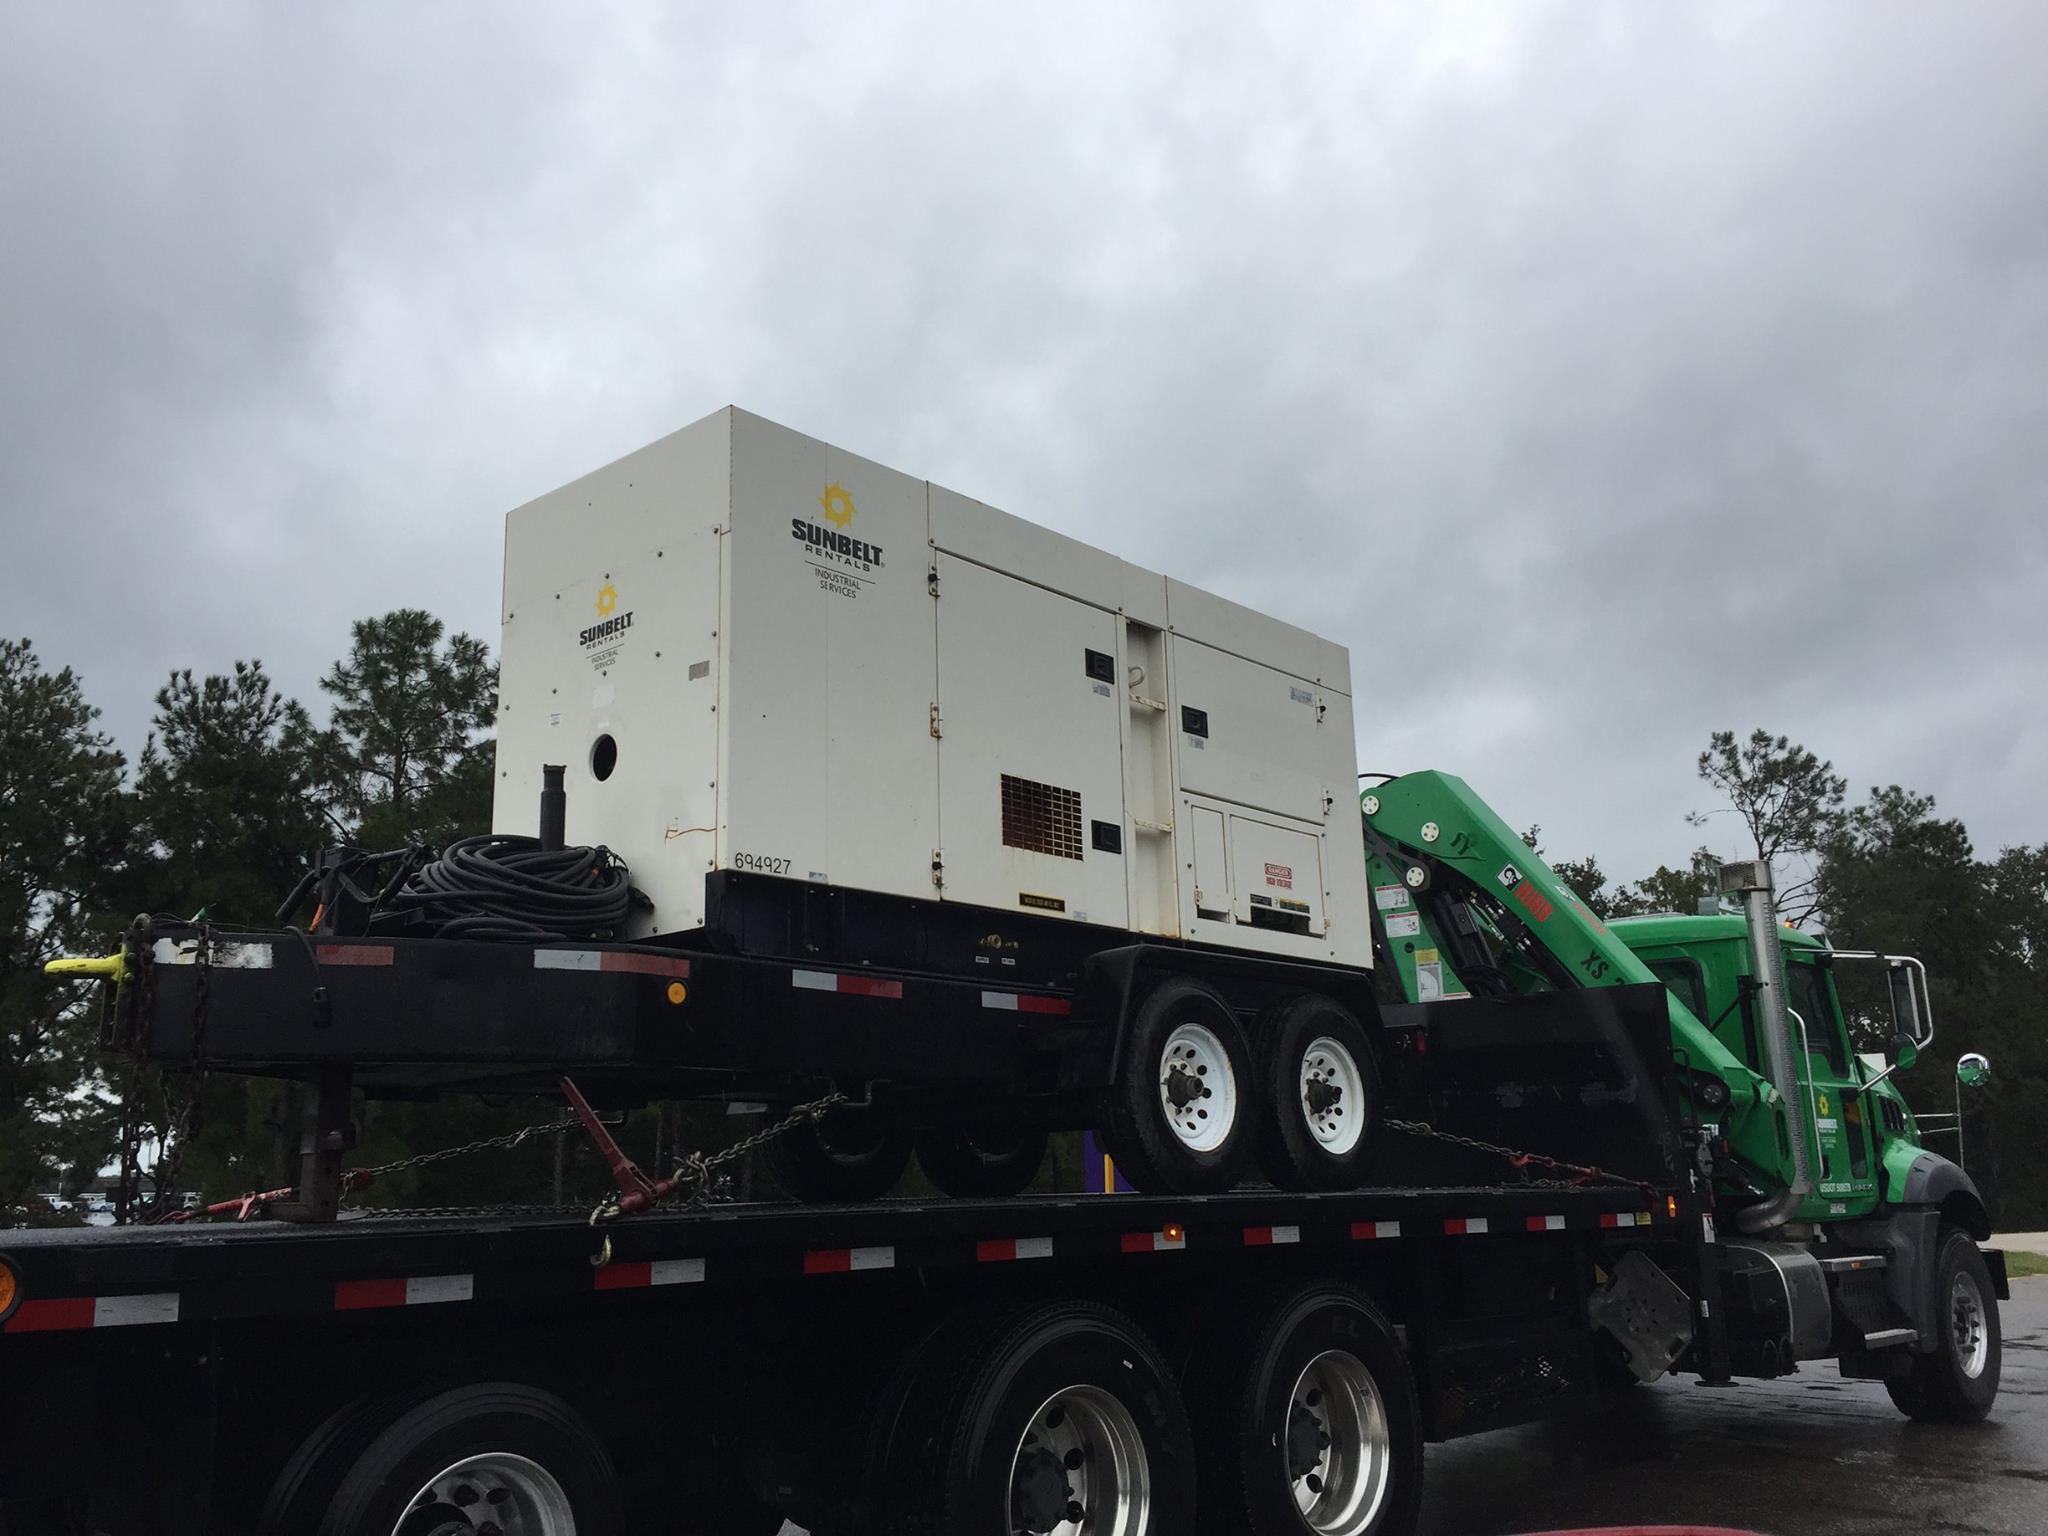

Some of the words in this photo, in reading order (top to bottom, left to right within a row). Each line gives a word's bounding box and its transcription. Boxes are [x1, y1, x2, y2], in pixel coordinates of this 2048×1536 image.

[792, 518, 883, 567] SUNBELT
[805, 544, 870, 572] RENTALS
[815, 568, 861, 591] INDUSTRIAL
[820, 580, 857, 599] SERVICES
[579, 611, 634, 646] SUNBELT
[586, 631, 625, 650] RENTALS
[735, 852, 791, 875] 694927
[1581, 949, 1608, 979] XS
